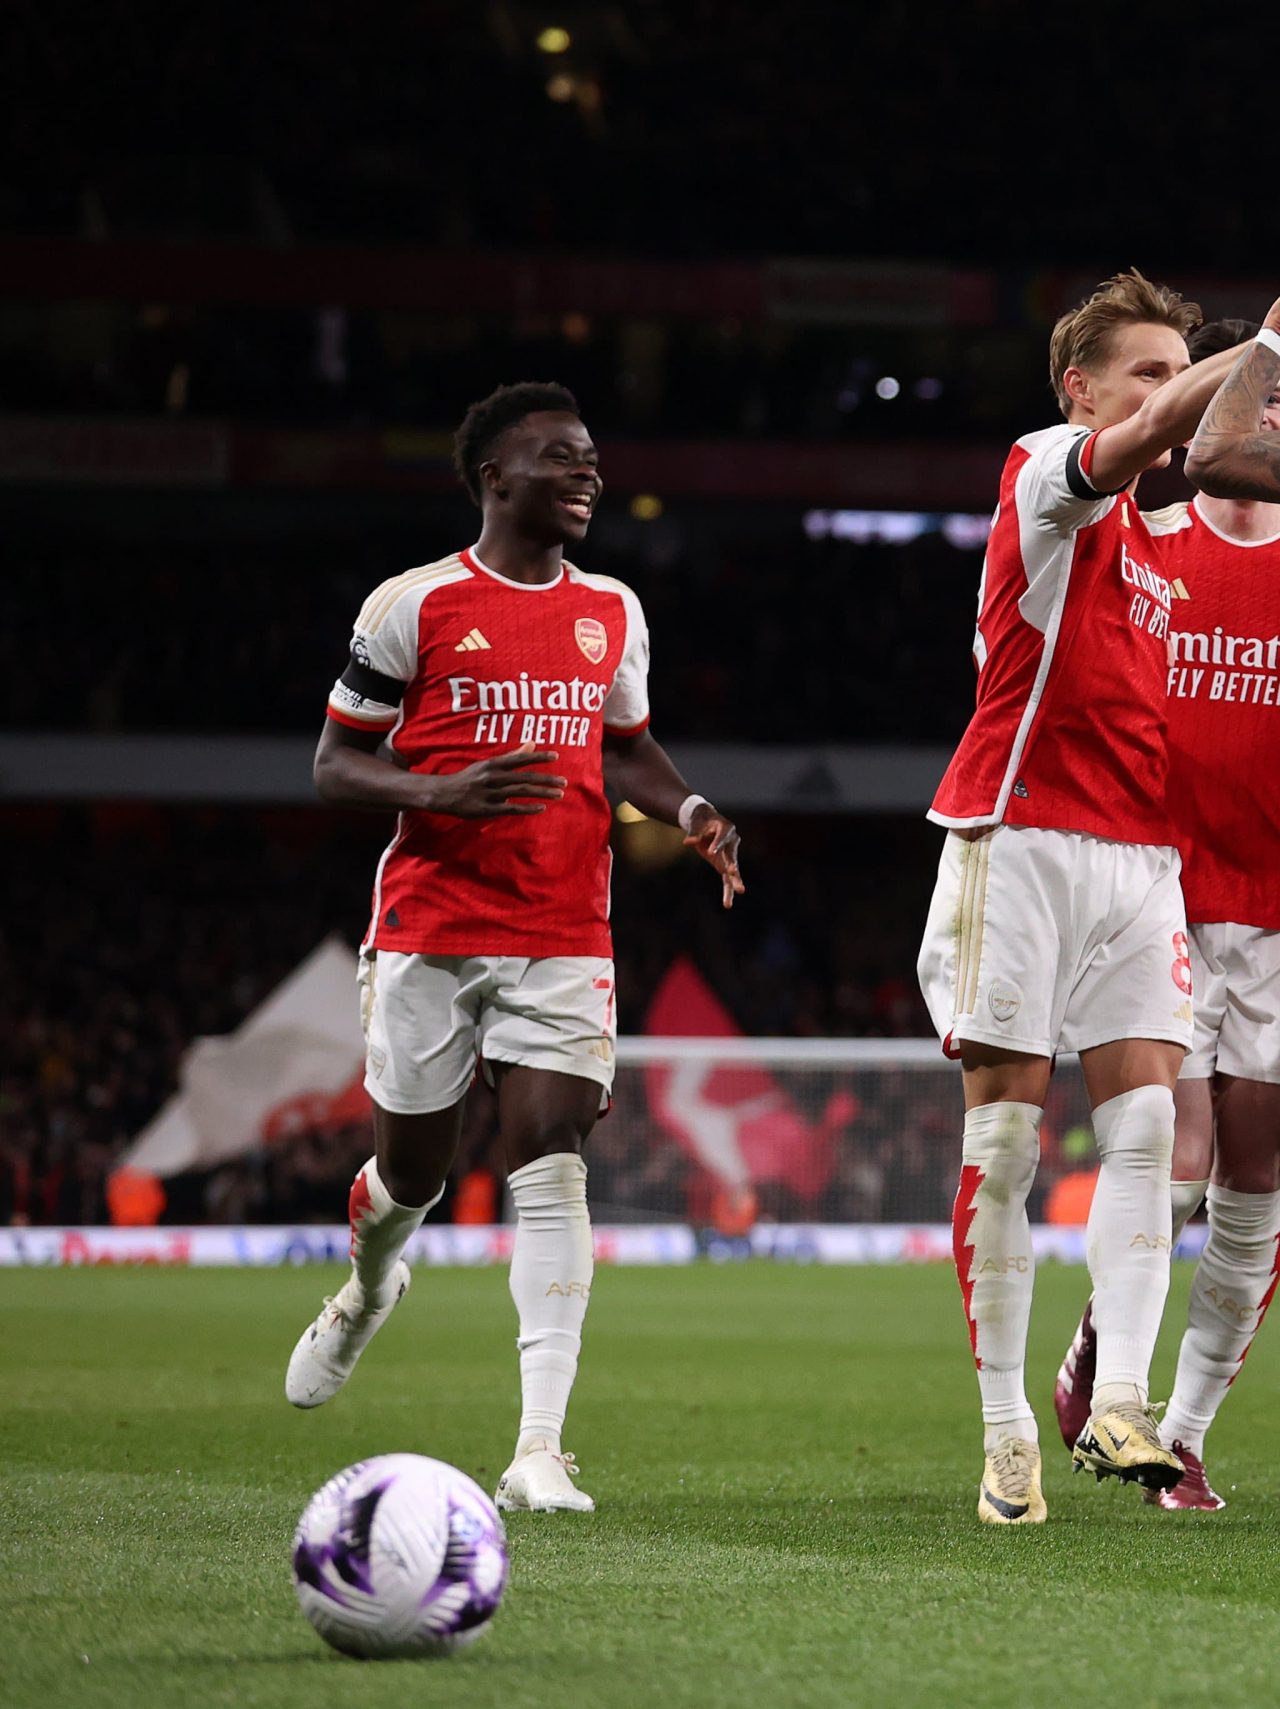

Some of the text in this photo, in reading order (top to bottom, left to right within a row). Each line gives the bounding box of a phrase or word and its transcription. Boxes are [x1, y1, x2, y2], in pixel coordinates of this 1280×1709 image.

[1129, 593, 1152, 629] FLY
[448, 671, 607, 713] Emirates
[1167, 667, 1205, 698] FLY
[474, 714, 590, 747] FLY BETTER
[1171, 931, 1192, 996] 8
[1129, 1232, 1169, 1254] AF
[978, 1256, 1028, 1274] AFC
